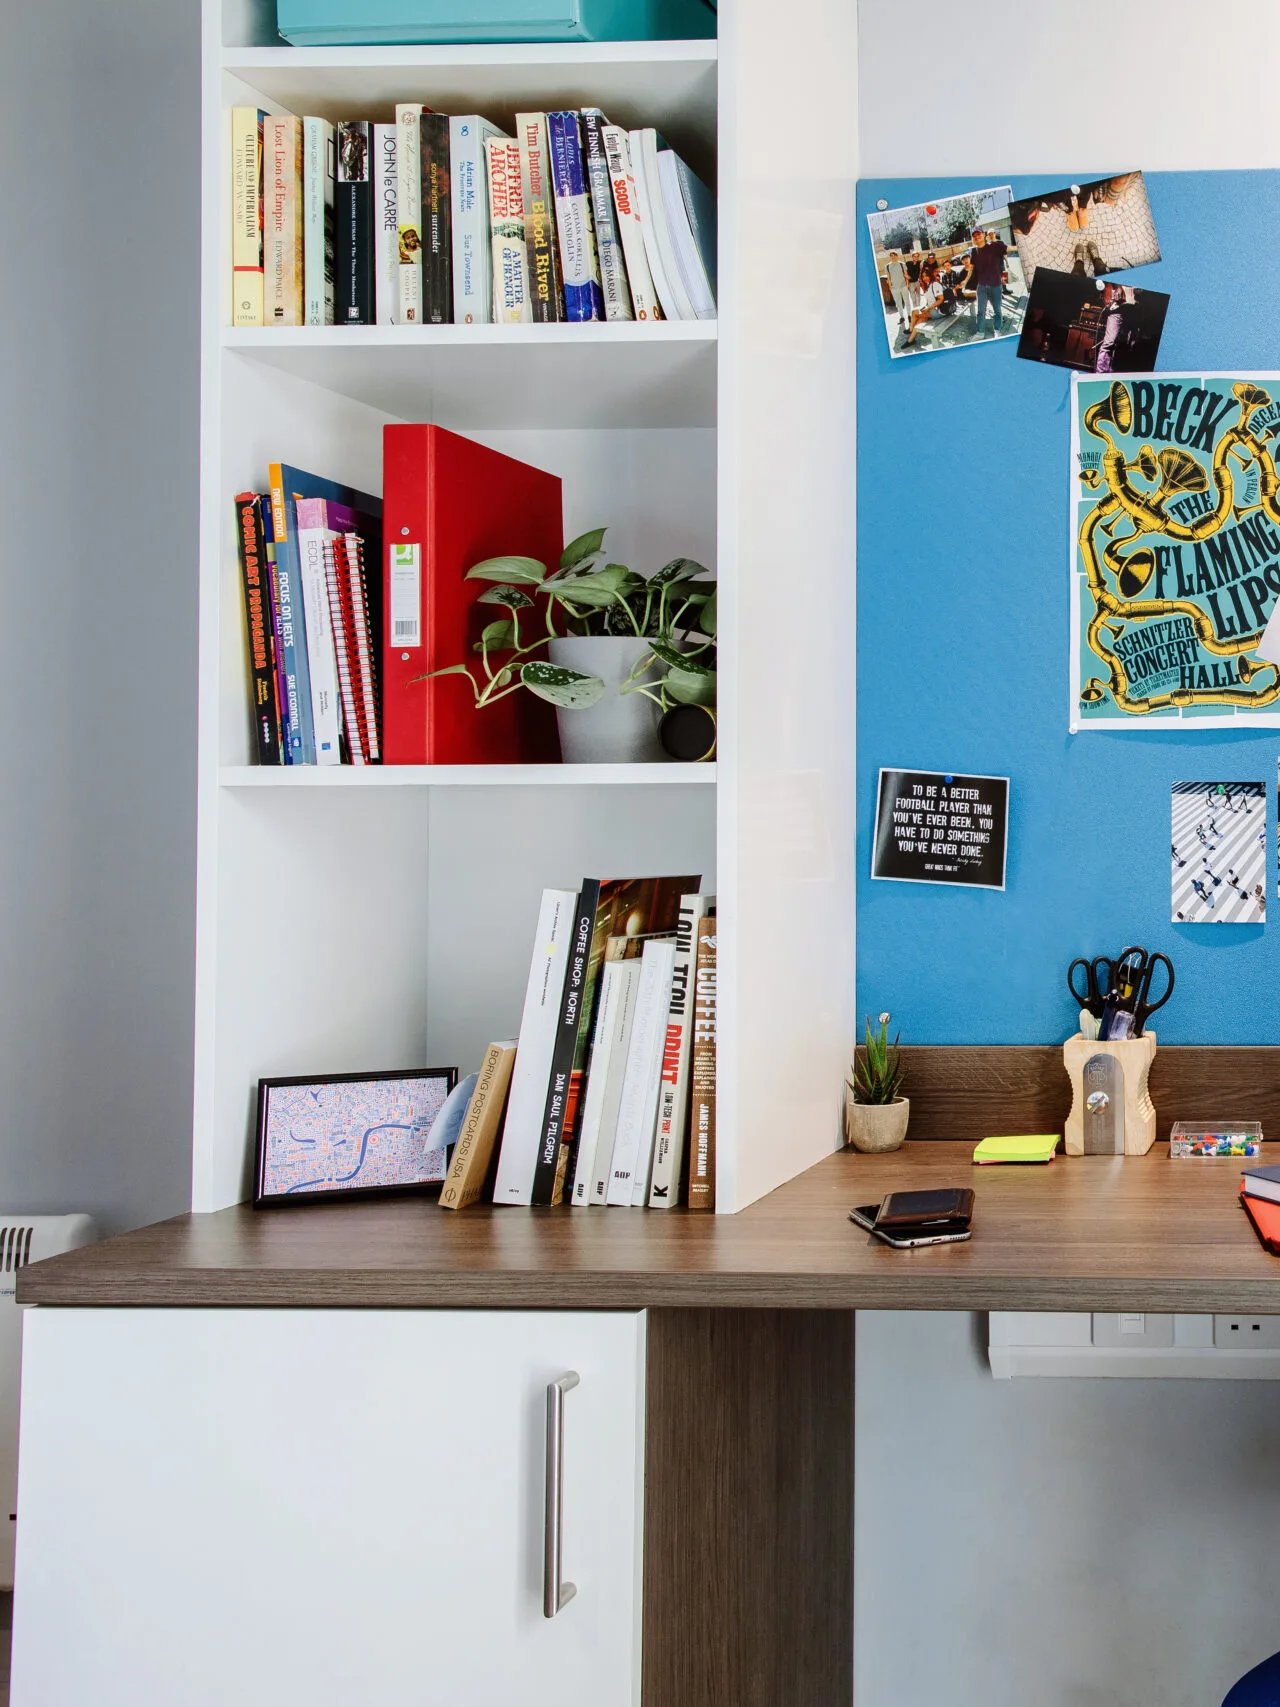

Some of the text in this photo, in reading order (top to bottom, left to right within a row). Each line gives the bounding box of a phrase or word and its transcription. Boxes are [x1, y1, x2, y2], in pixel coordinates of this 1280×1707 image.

[245, 134, 256, 169] CULTURE
[270, 124, 286, 232] Lost Lion of Empire
[466, 161, 475, 187] Adrian
[526, 123, 543, 196] Tim Butcher
[565, 136, 575, 164] Louis
[585, 110, 607, 217] NEW FINNISH GRAMMAR
[606, 133, 632, 216] Evelyn Waugh SCOOP
[383, 134, 399, 231] JOHN le CARRÉ
[430, 162, 440, 253] sonya hartnett surrender
[490, 144, 508, 218] ARCHER
[506, 144, 524, 220] JEFFREY
[245, 184, 256, 239] IMPERIALISM
[563, 213, 575, 262] MANDOLIN
[571, 202, 583, 235] CAPTAIN
[275, 240, 283, 300] EDWARD PAICE
[464, 234, 474, 296] Sue Townsend
[502, 248, 515, 308] OF HONOUR
[512, 250, 524, 304] A MATTER
[531, 200, 551, 301] Blood River
[602, 240, 617, 303] DIEGO MARANI
[1131, 381, 1240, 453] BECK
[1168, 491, 1216, 524] THE
[1242, 468, 1258, 505] IN PERSON
[307, 540, 318, 569] ECDL
[242, 506, 267, 669] COMIC ART PROPAGANDA
[271, 564, 281, 603] Vocabulary
[276, 615, 284, 636] IELTS
[279, 571, 295, 648] FOCUS ON IELTS
[1112, 616, 1195, 661] SCHNITZER
[1124, 637, 1200, 684] CONCERT
[287, 675, 300, 731] SUE O'CONNELL
[1179, 661, 1242, 689] HALL
[892, 811, 994, 831] YOU'VE EVER BEEN, YOU
[895, 797, 993, 816] FOOTBALL PLAYER THAN
[912, 785, 980, 801] TO BE A BETTER
[894, 826, 991, 844] HAVE TO DO SOMETHING
[898, 840, 984, 858] YOU'VE NEVER DONE.
[565, 917, 590, 1025] COFFEE SHOP: NORTH
[694, 967, 717, 1044] COFFEE
[451, 1049, 500, 1179] BORING POSTCARDS USA
[543, 1073, 566, 1164] DAN SAUL PILGRIM
[661, 1092, 674, 1134] LOW-TECH PRINT
[697, 1103, 709, 1177] JAMES HOFFMANN
[653, 1184, 669, 1198] K
